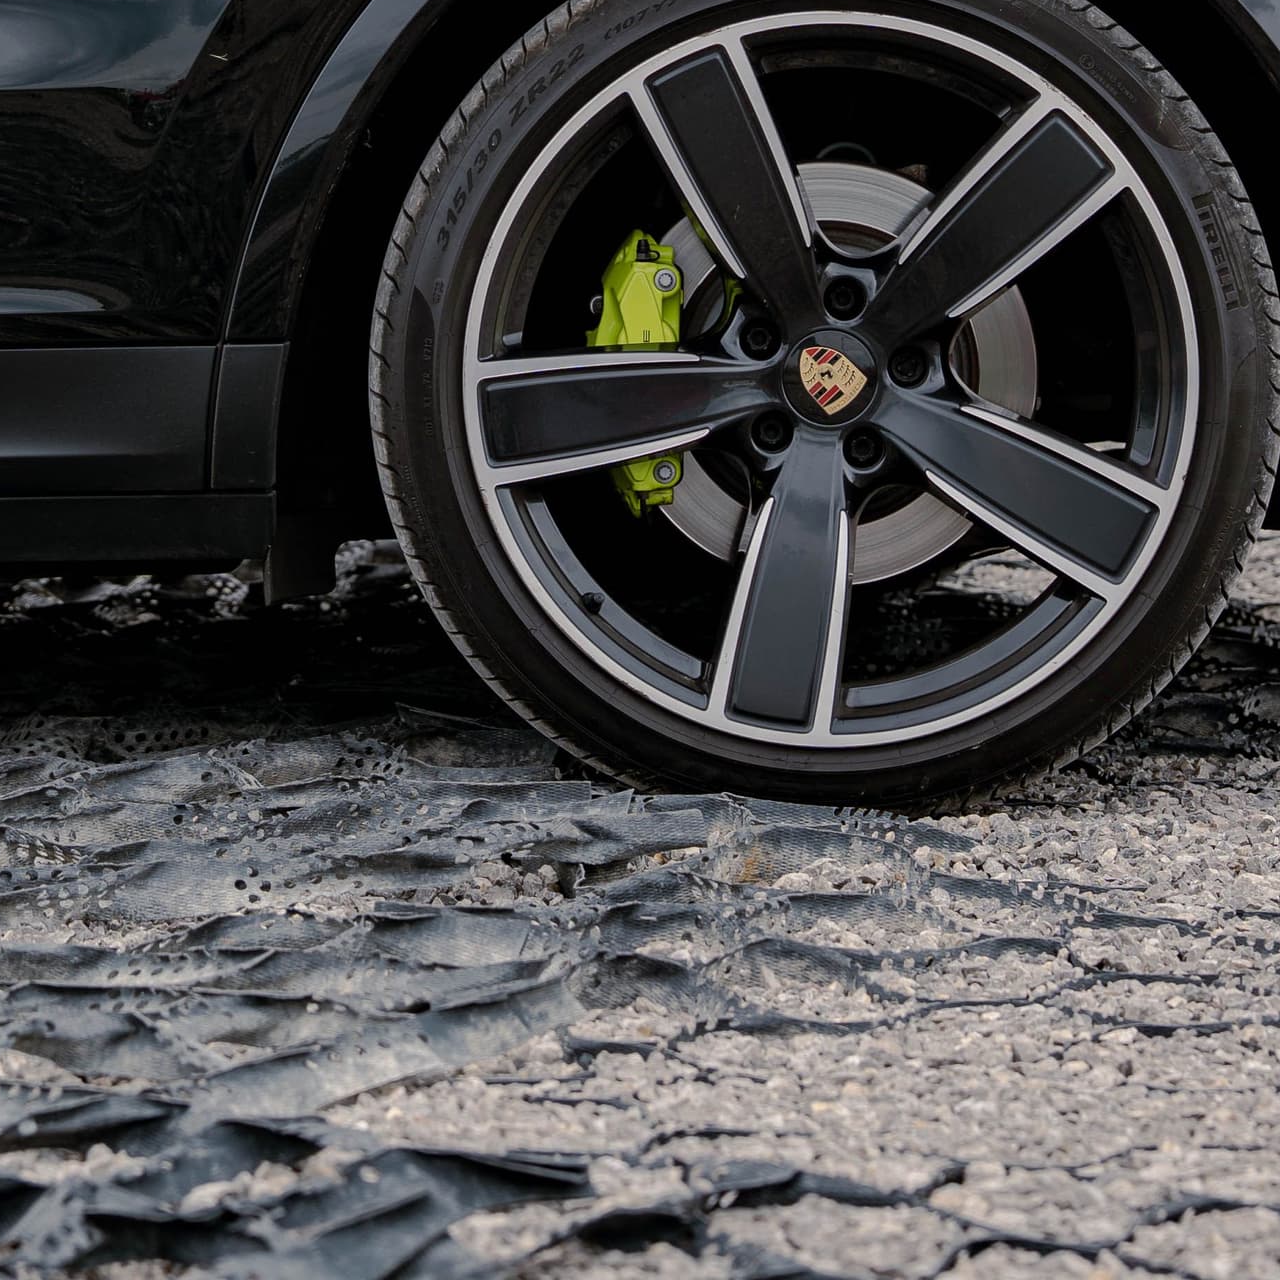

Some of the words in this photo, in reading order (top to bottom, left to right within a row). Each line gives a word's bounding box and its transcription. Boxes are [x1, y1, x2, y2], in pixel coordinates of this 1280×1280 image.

[436, 128, 503, 253] 315/30
[508, 43, 585, 126] ZR22
[1191, 192, 1249, 309] PIRELLI
